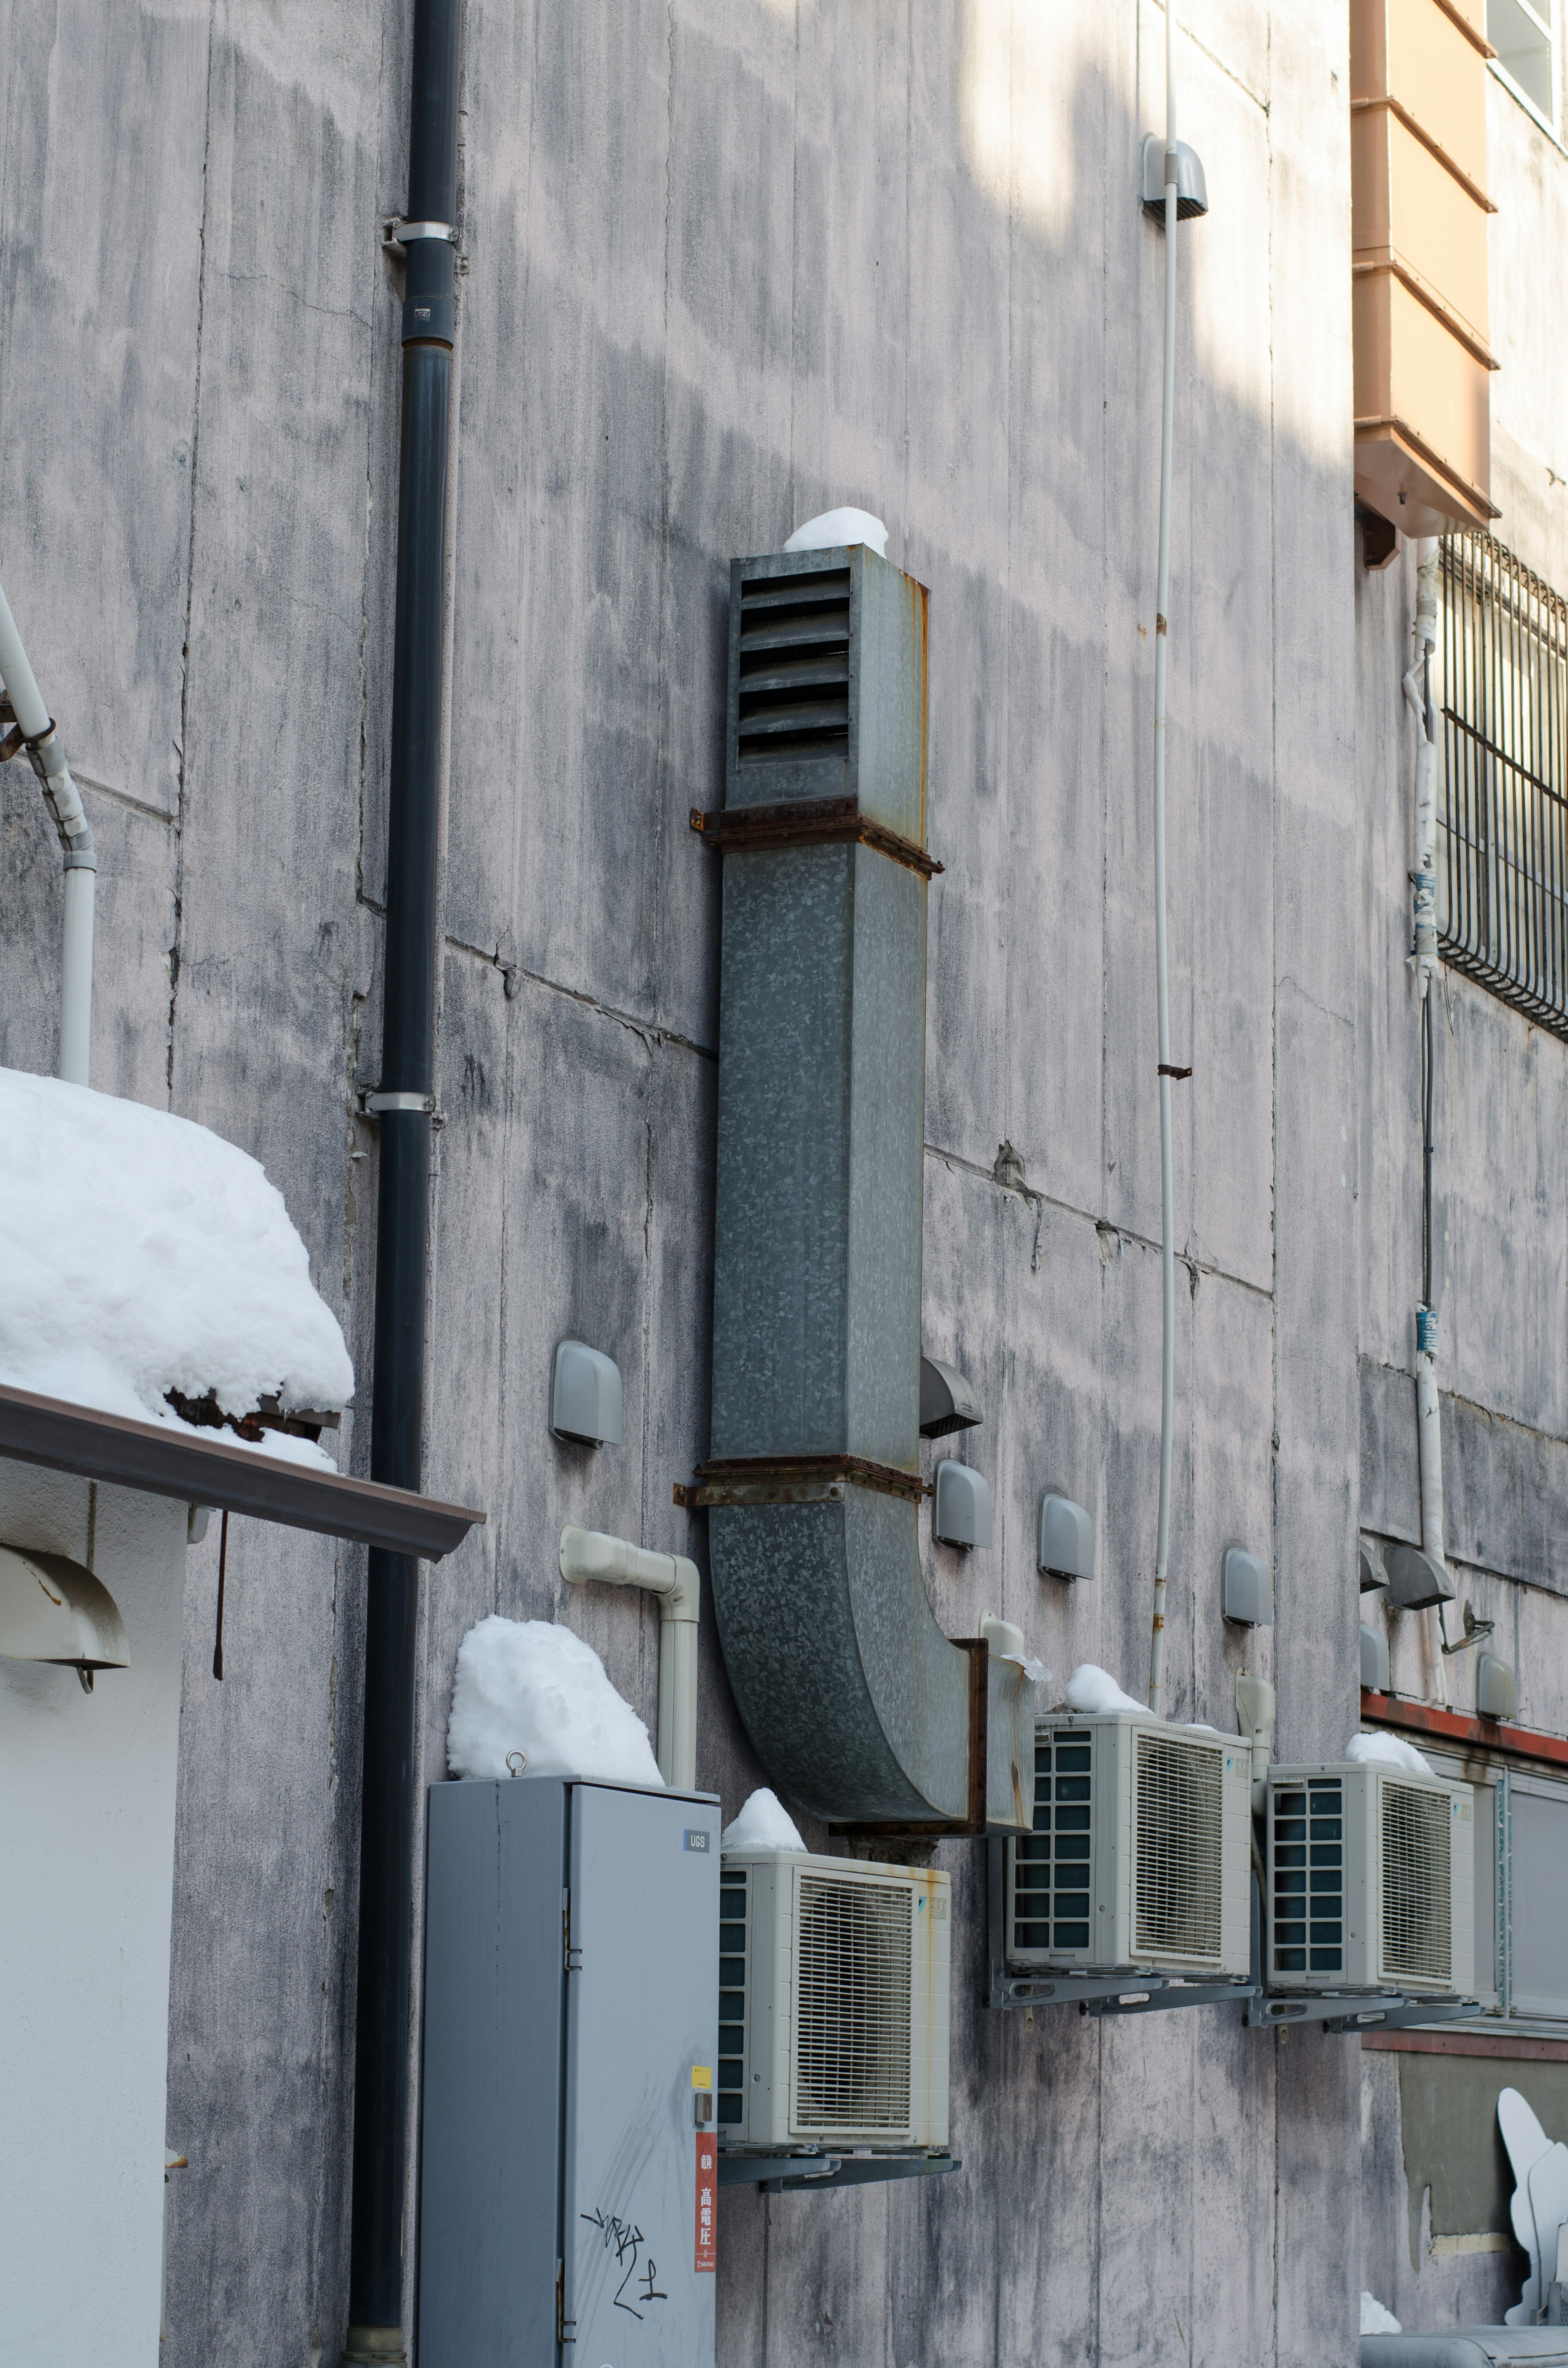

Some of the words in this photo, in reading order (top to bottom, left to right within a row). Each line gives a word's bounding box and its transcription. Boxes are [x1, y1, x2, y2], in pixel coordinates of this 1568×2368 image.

[690, 1835, 705, 1848] UGS
[701, 2154, 712, 2170] 危険
[700, 2187, 712, 2245] 高電圧
